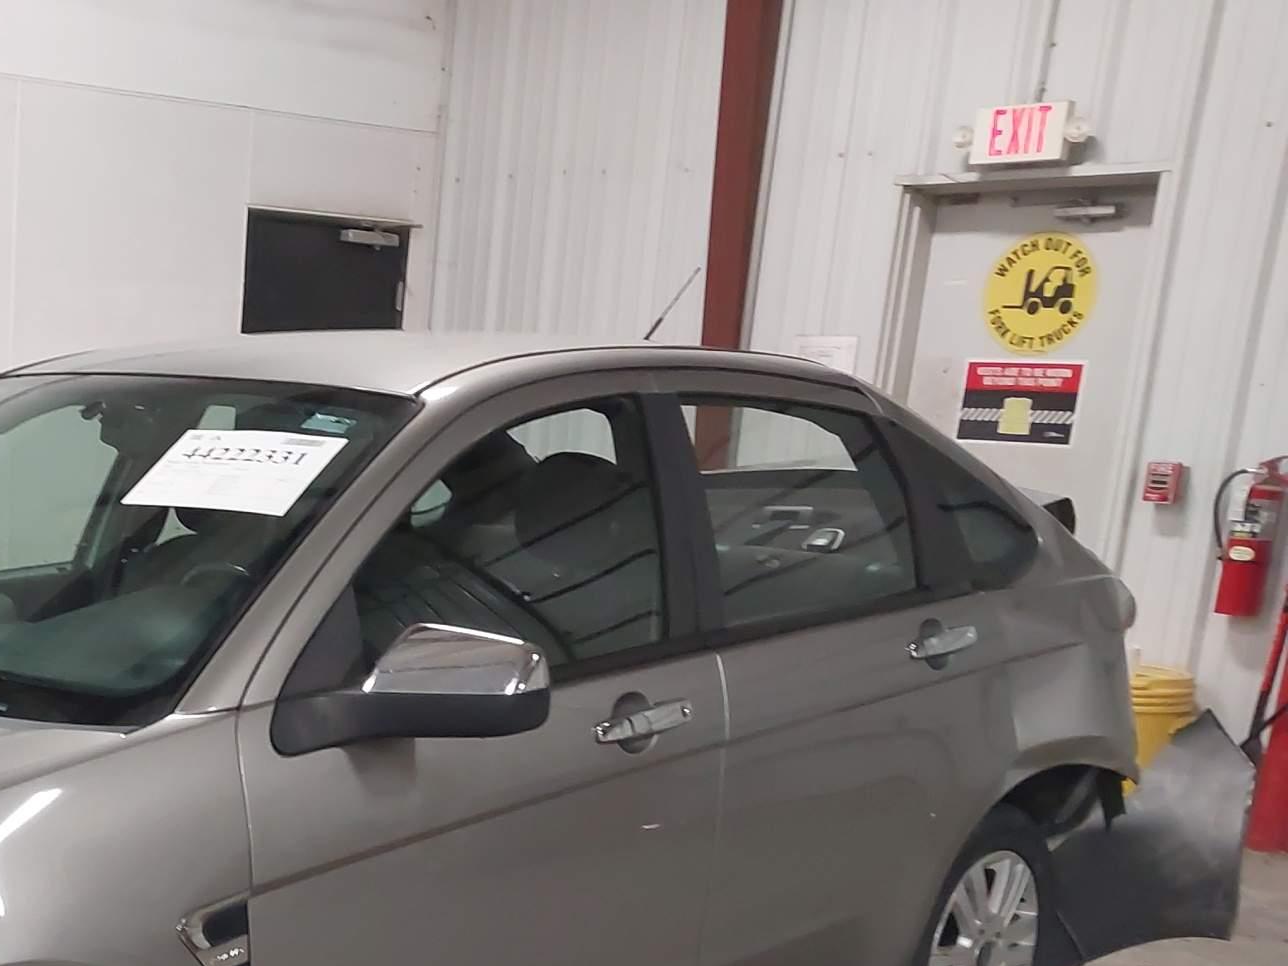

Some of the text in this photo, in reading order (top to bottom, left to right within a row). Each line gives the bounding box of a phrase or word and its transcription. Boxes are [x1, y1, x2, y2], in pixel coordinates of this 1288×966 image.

[988, 105, 1053, 157] EXIT
[994, 237, 1092, 278] WATCH OUT FOR
[988, 309, 1084, 349] FORK LIFT TRUCKS
[181, 446, 308, 466] 44222331
